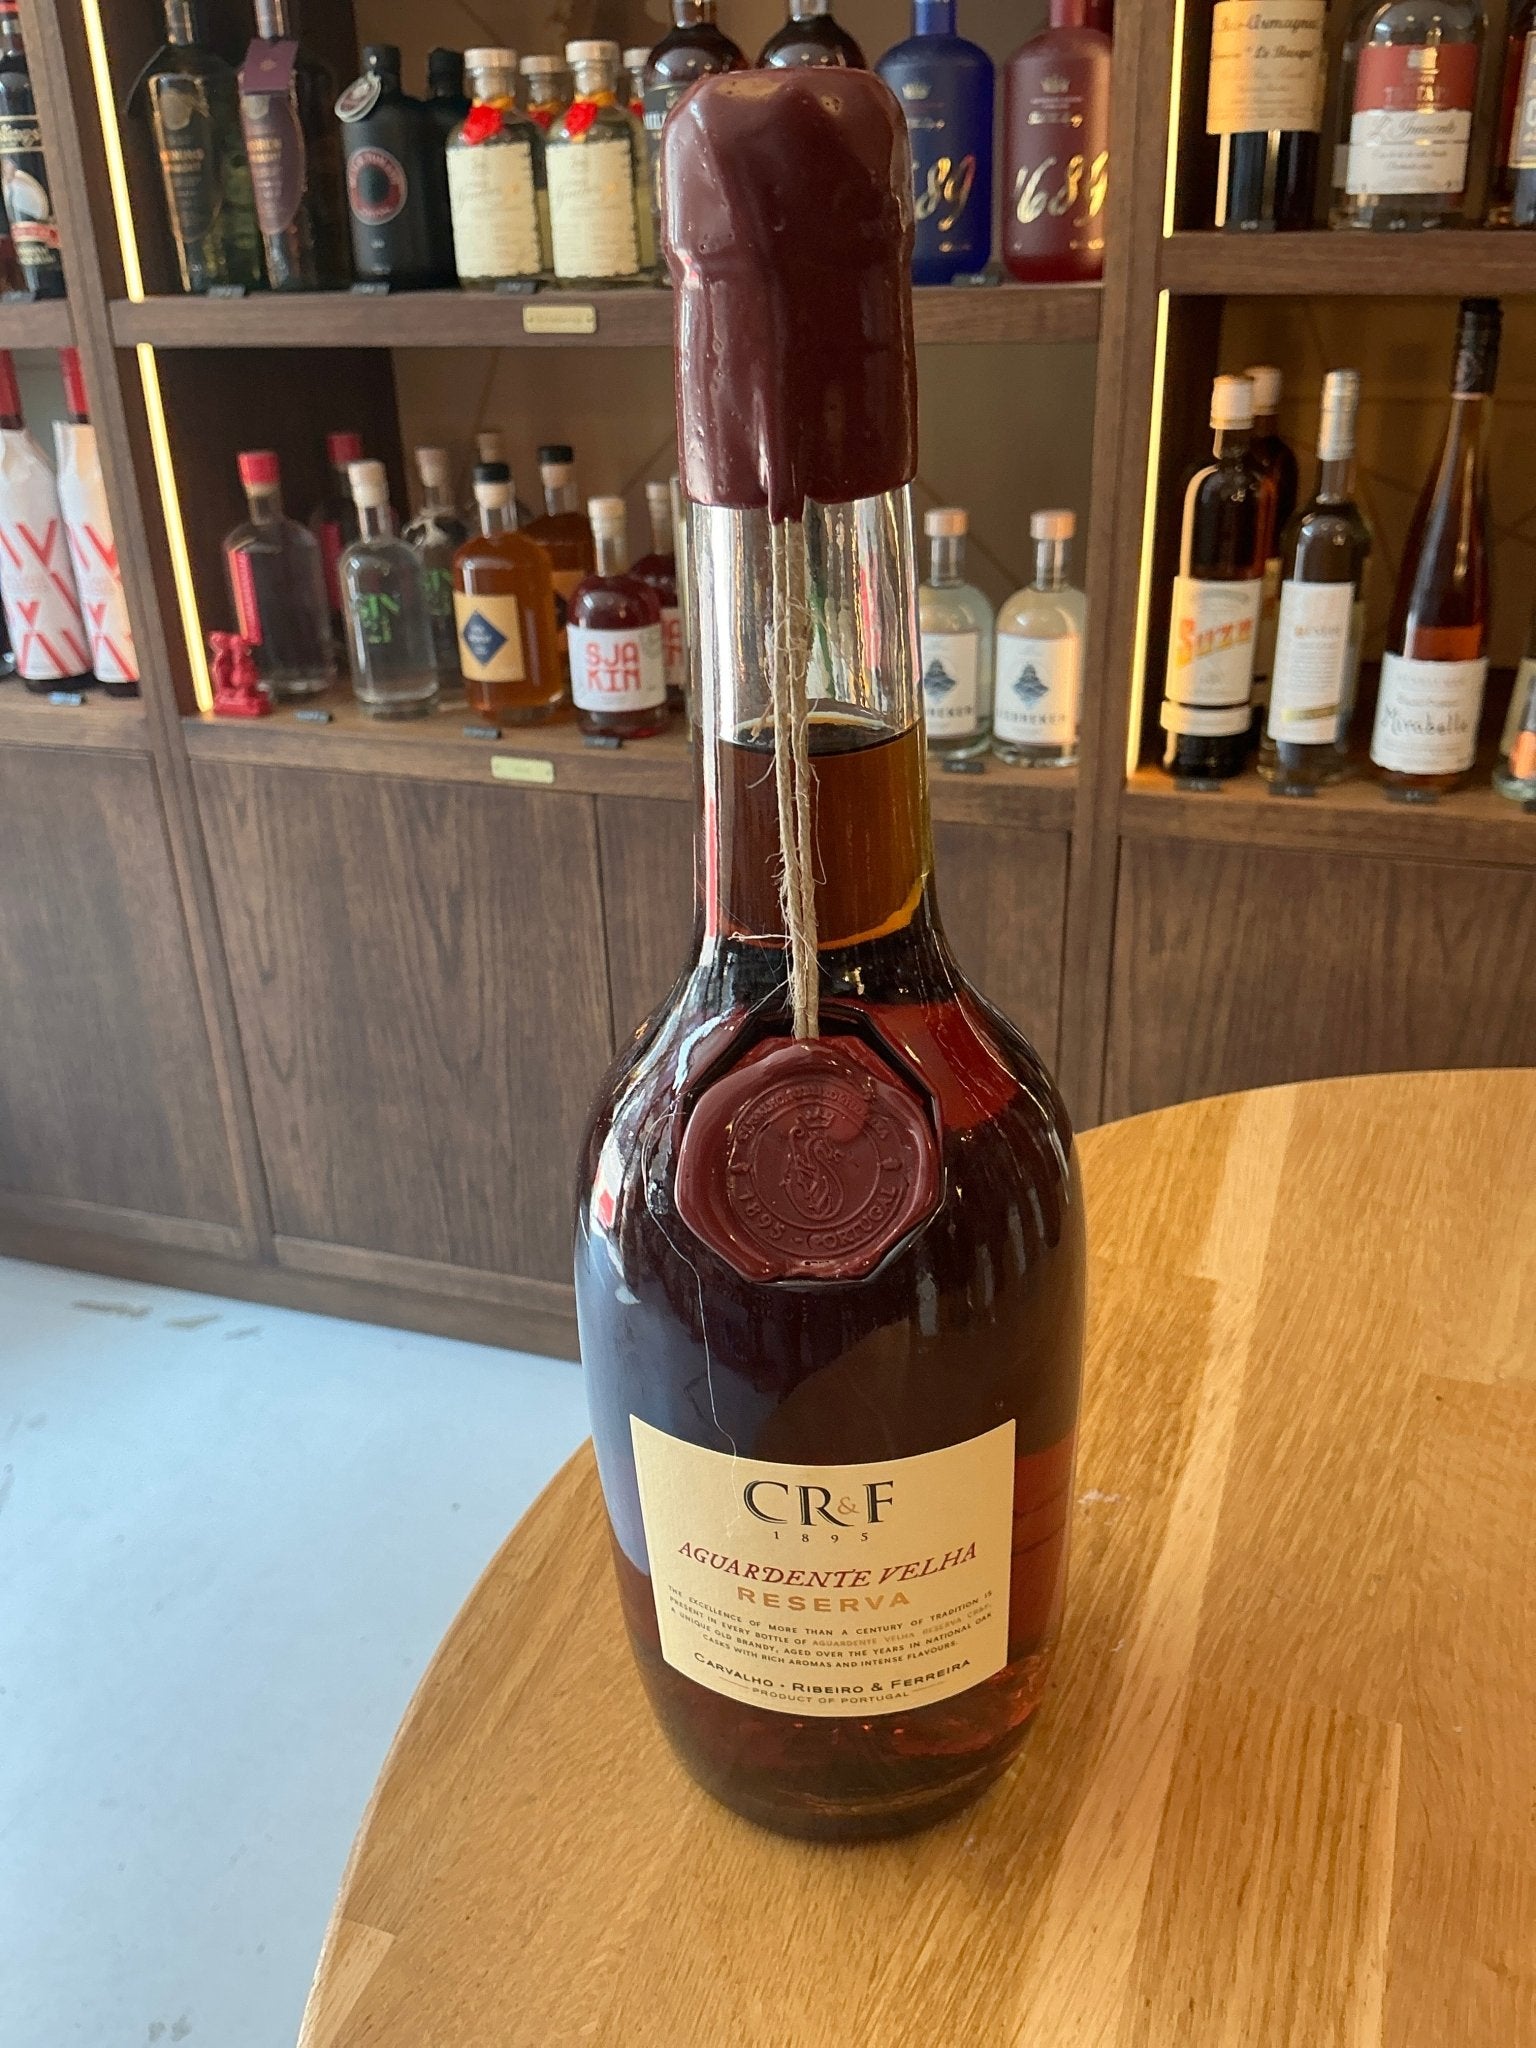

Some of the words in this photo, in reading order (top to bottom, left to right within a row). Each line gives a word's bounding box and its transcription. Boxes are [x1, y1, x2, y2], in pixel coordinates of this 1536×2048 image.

[586, 642, 639, 666] SJA
[587, 668, 641, 693] KIN
[743, 1480, 895, 1527] CR&F
[773, 1530, 869, 1543] 1895
[678, 1541, 872, 1589] AGUARDENTE
[878, 1541, 978, 1586] VELHA
[668, 1584, 683, 1598] THE
[689, 1596, 743, 1623] EXCELLENCE
[749, 1619, 761, 1628] OF
[768, 1623, 798, 1634] MORE
[805, 1628, 834, 1636] THAN
[855, 1622, 903, 1636] CENTURY
[910, 1618, 924, 1627] OF
[930, 1597, 980, 1622] TRADITION
[984, 1589, 993, 1599] IS
[737, 1586, 911, 1613] RESERVA
[669, 1595, 704, 1619] PRESENT
[707, 1615, 717, 1625] IN
[721, 1621, 751, 1636] EVERY
[755, 1632, 789, 1644] BOTTLE
[794, 1638, 808, 1646] OF
[812, 1637, 878, 1648] AGUARDENTE
[883, 1631, 915, 1643] VELHA
[922, 1616, 962, 1635] RESERVA
[679, 1612, 711, 1632] UNIQUE
[714, 1628, 732, 1640] OLD
[736, 1637, 779, 1654] BRANDY,
[783, 1647, 811, 1656] AGED
[849, 1649, 868, 1657] THE
[873, 1644, 905, 1655] YEARS
[909, 1640, 921, 1649] IN
[925, 1623, 972, 1645] NATIONAL
[975, 1612, 992, 1625] OAK
[702, 1633, 731, 1650] CASKS
[733, 1645, 758, 1658] WITH
[761, 1653, 785, 1664] RICH
[788, 1658, 832, 1668] AROMAS
[860, 1655, 903, 1667] INTENSE
[906, 1640, 958, 1661] FLAVOURS.
[752, 1687, 812, 1703] PRODUCT
[840, 1691, 910, 1704] PORTUGAL
[870, 1682, 884, 1692] &
